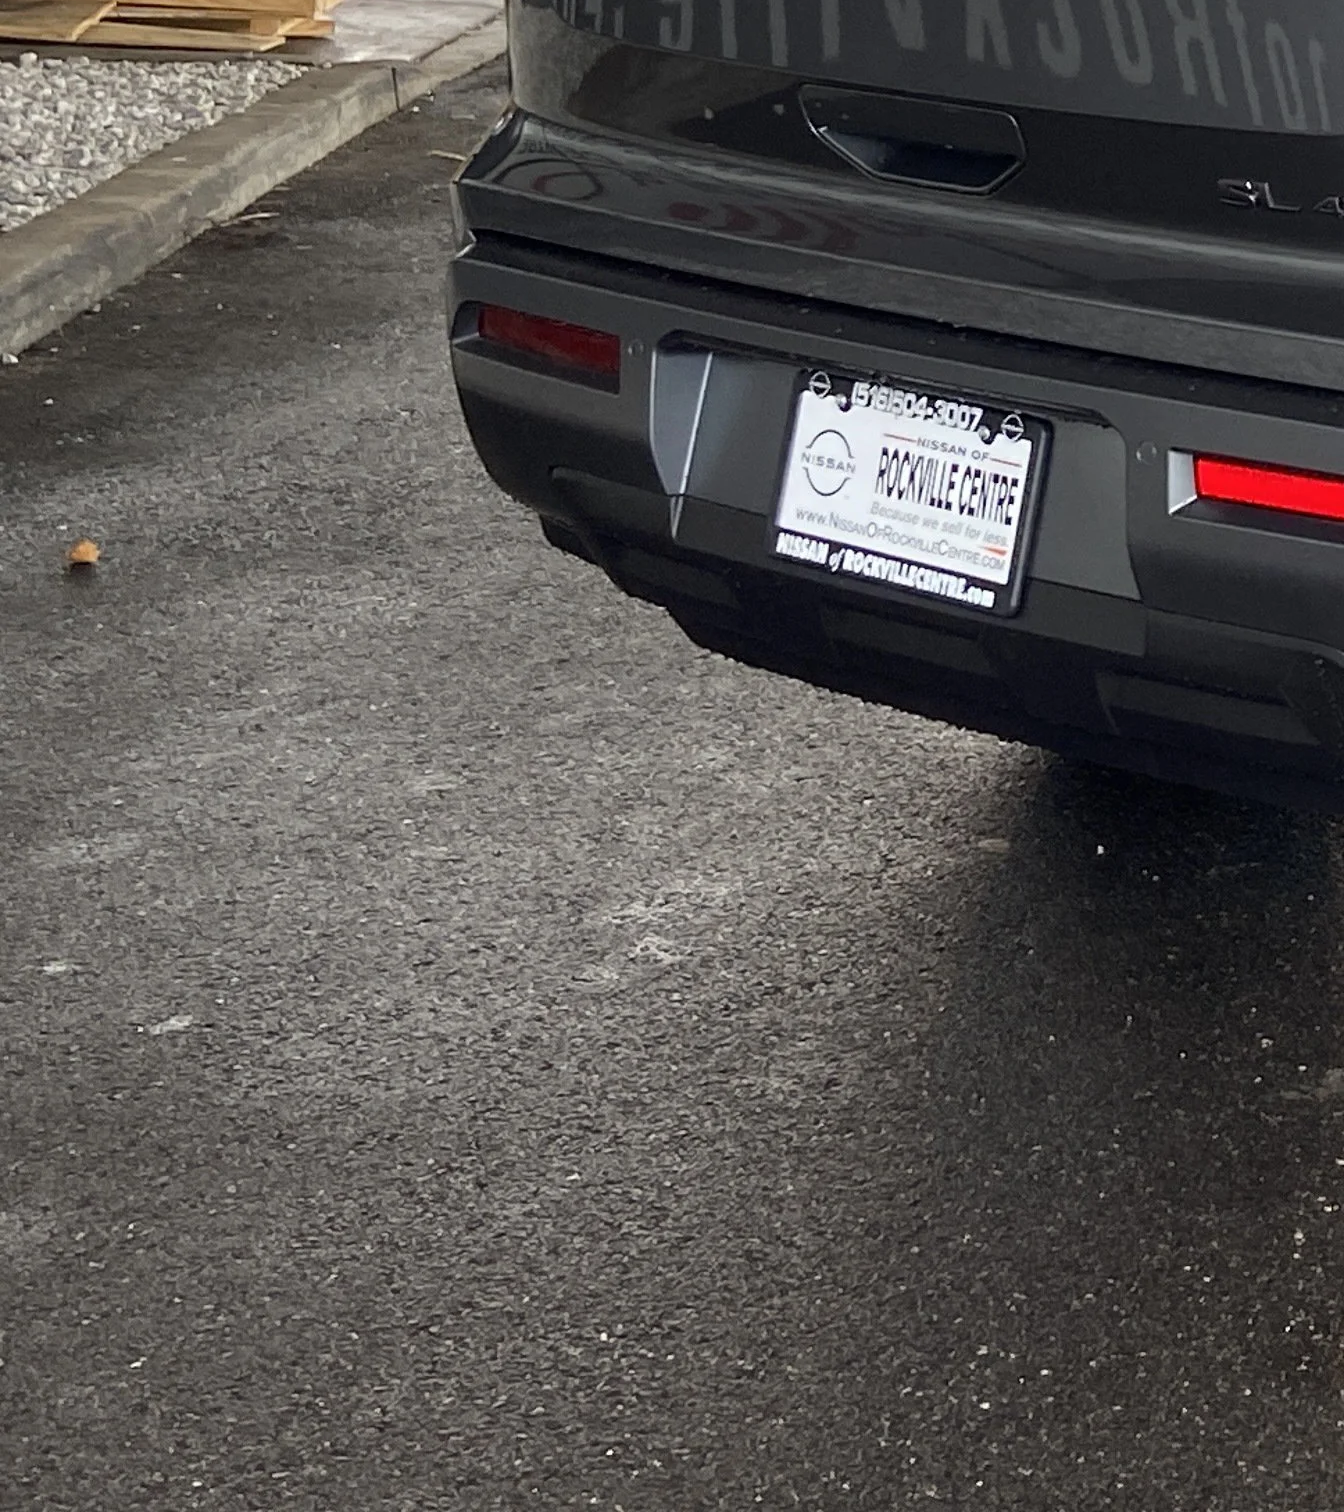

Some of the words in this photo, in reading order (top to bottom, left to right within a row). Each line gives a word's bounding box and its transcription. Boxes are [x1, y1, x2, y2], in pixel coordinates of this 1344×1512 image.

[1216, 178, 1301, 212] SL
[801, 451, 856, 473] NISSAN
[916, 437, 967, 457] NISSAN
[971, 449, 990, 461] OF
[874, 446, 959, 512] ROCKVILLE
[958, 465, 1019, 526] CENTRE
[870, 501, 920, 525] Because
[776, 532, 829, 564] NISSAN
